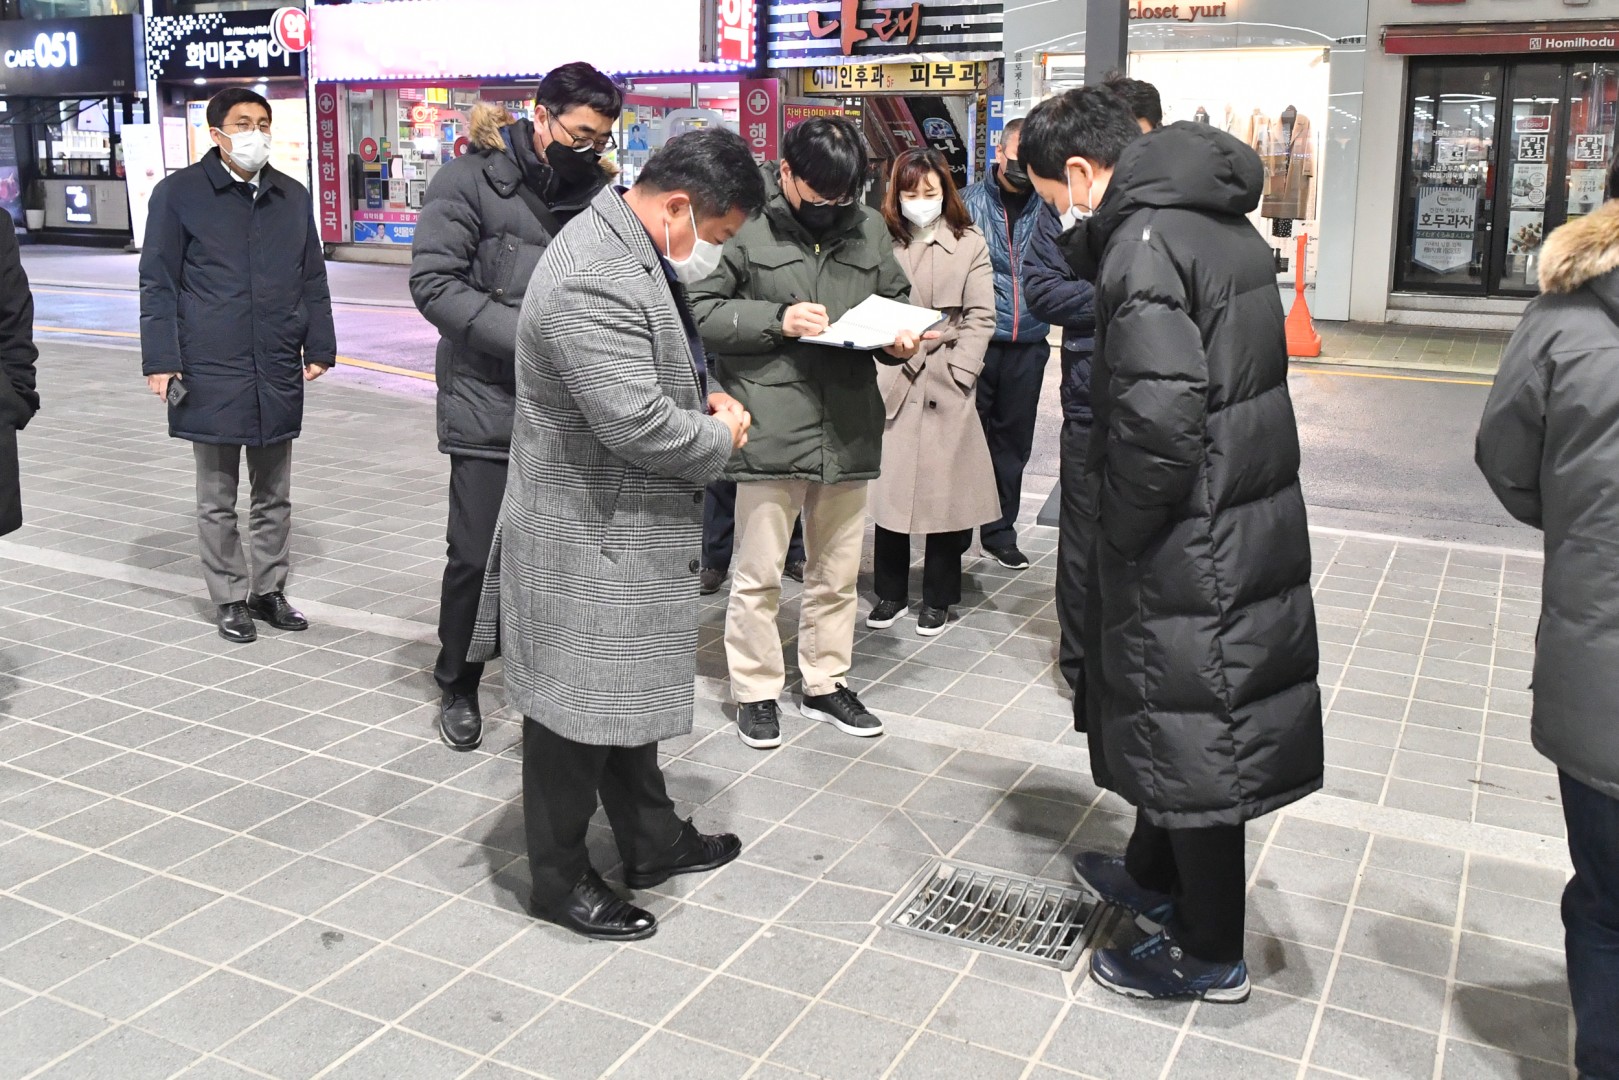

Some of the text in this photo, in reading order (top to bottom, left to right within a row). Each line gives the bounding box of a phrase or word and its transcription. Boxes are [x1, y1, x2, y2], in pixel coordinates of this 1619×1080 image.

[1128, 1, 1226, 22] closet_yuri
[284, 14, 306, 47] 약
[721, 0, 753, 60] 약
[809, 0, 920, 56] 나래
[1545, 37, 1615, 49] Homilhodu
[4, 32, 78, 68] CAFE 051
[812, 65, 884, 89] 이비인후과
[909, 58, 981, 88] 피부과
[1522, 121, 1544, 129] closed
[321, 119, 338, 231] 행복한 약국
[1418, 213, 1473, 229] 호두과자
